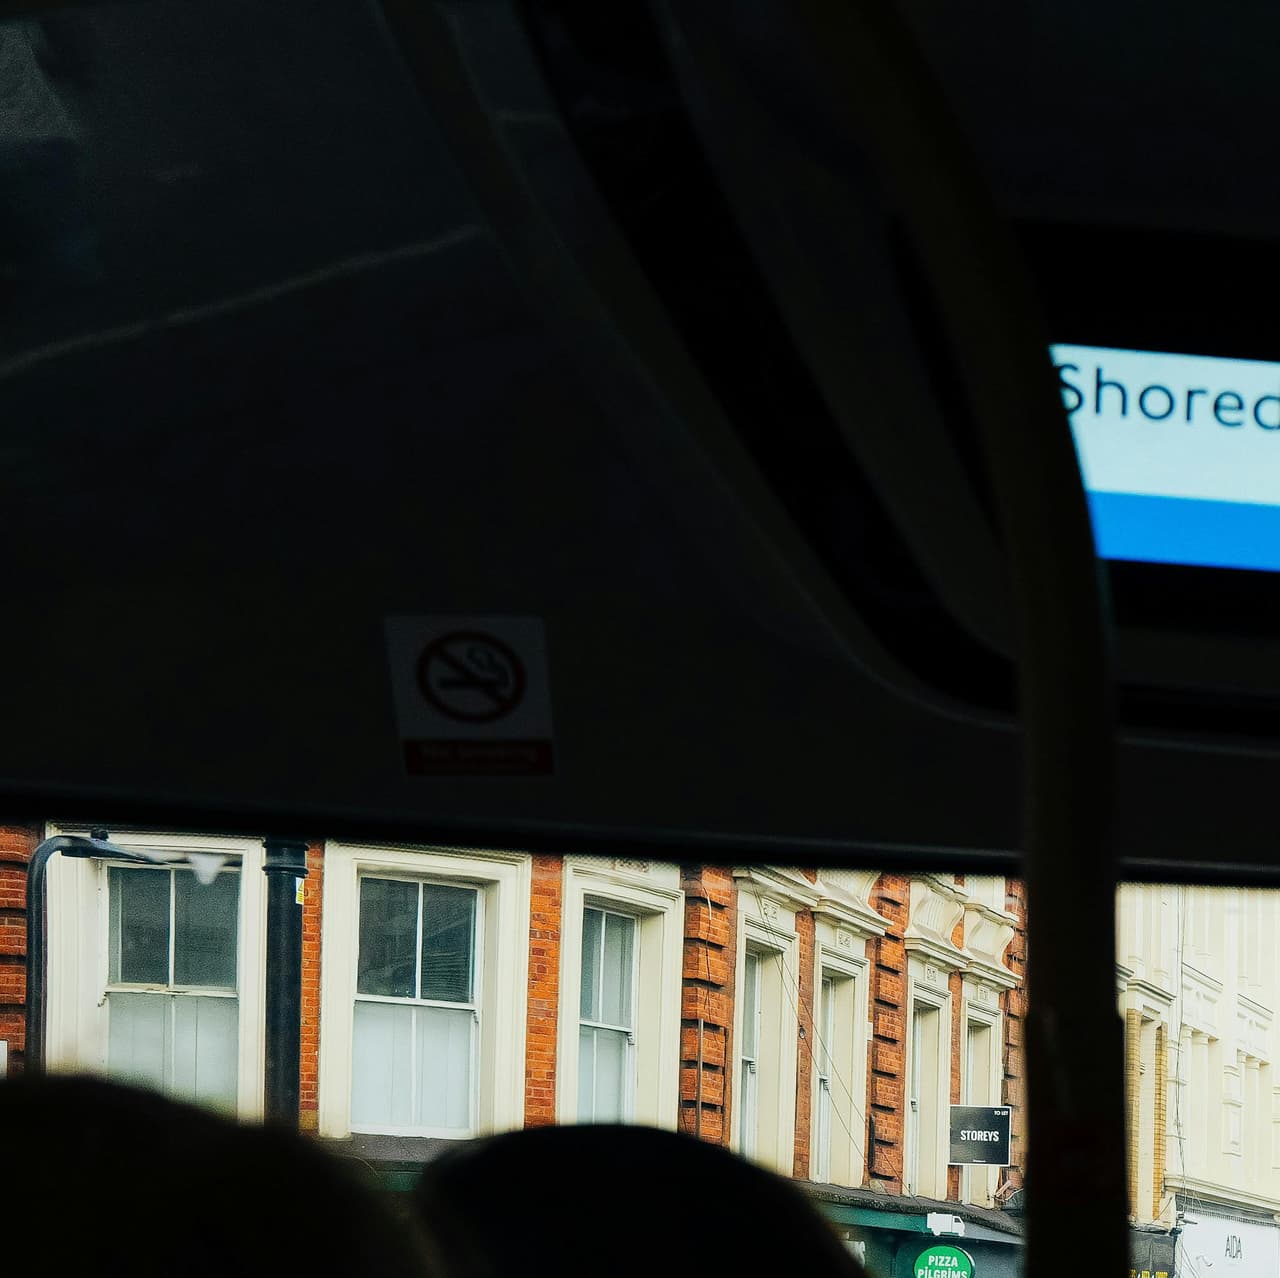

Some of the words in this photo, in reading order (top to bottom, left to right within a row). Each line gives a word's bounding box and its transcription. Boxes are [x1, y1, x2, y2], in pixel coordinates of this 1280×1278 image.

[960, 1129, 1000, 1142] STOREYS
[1225, 1235, 1243, 1259] AIDA
[928, 1255, 959, 1267] PIZZA
